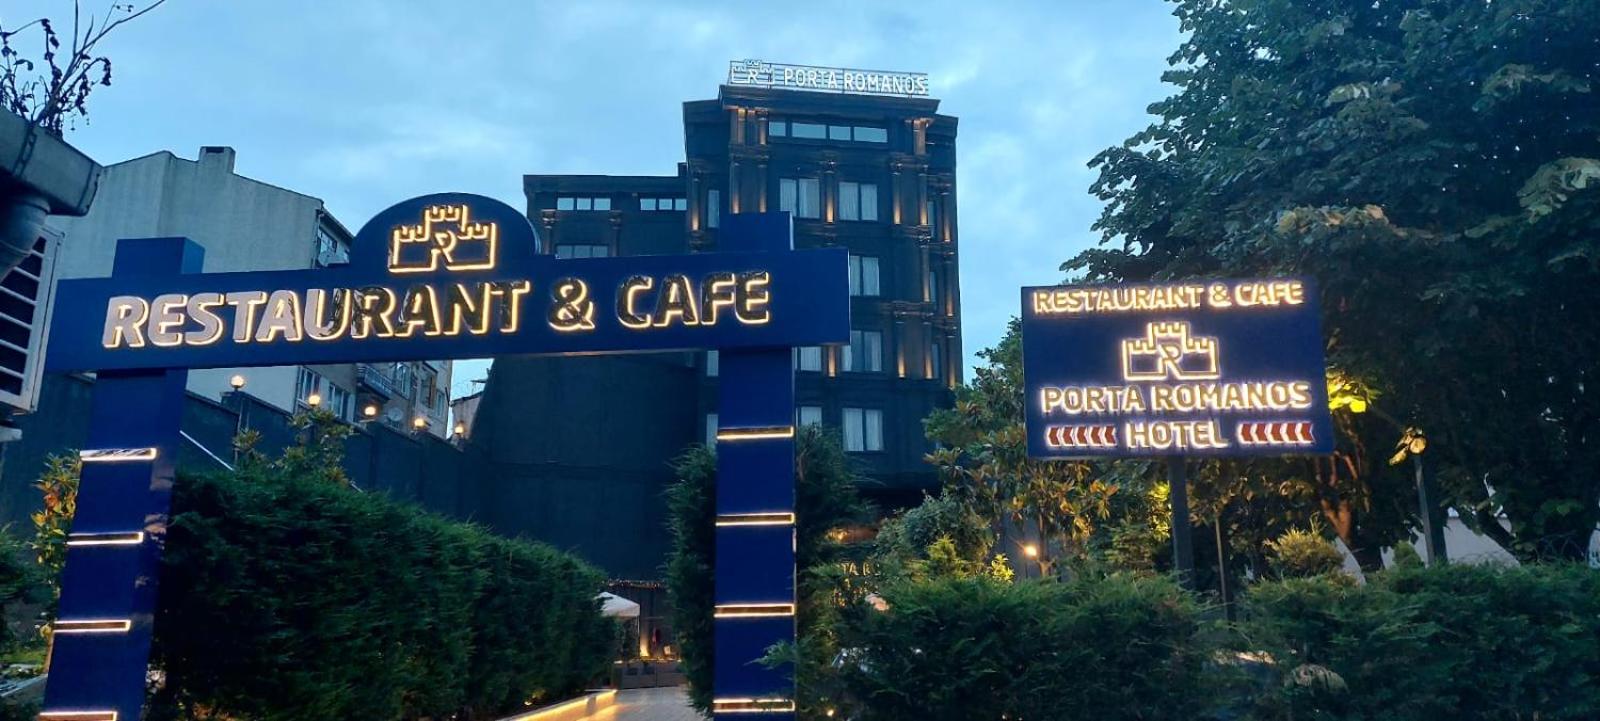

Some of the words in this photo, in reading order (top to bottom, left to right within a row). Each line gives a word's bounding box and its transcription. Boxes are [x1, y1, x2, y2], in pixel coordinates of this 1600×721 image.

[784, 68, 838, 88] PORTA
[844, 70, 927, 94] ROMANOS
[102, 280, 531, 348] RESTAURANT
[548, 277, 596, 331] &
[616, 271, 769, 329] CAFE
[1033, 286, 1205, 313] RESTAURANT
[1208, 282, 1232, 308] &
[1235, 281, 1304, 306] CAFE
[1041, 385, 1145, 414] PORTA
[1151, 381, 1312, 412] ROMANOS
[1126, 421, 1229, 449] HOTEL
